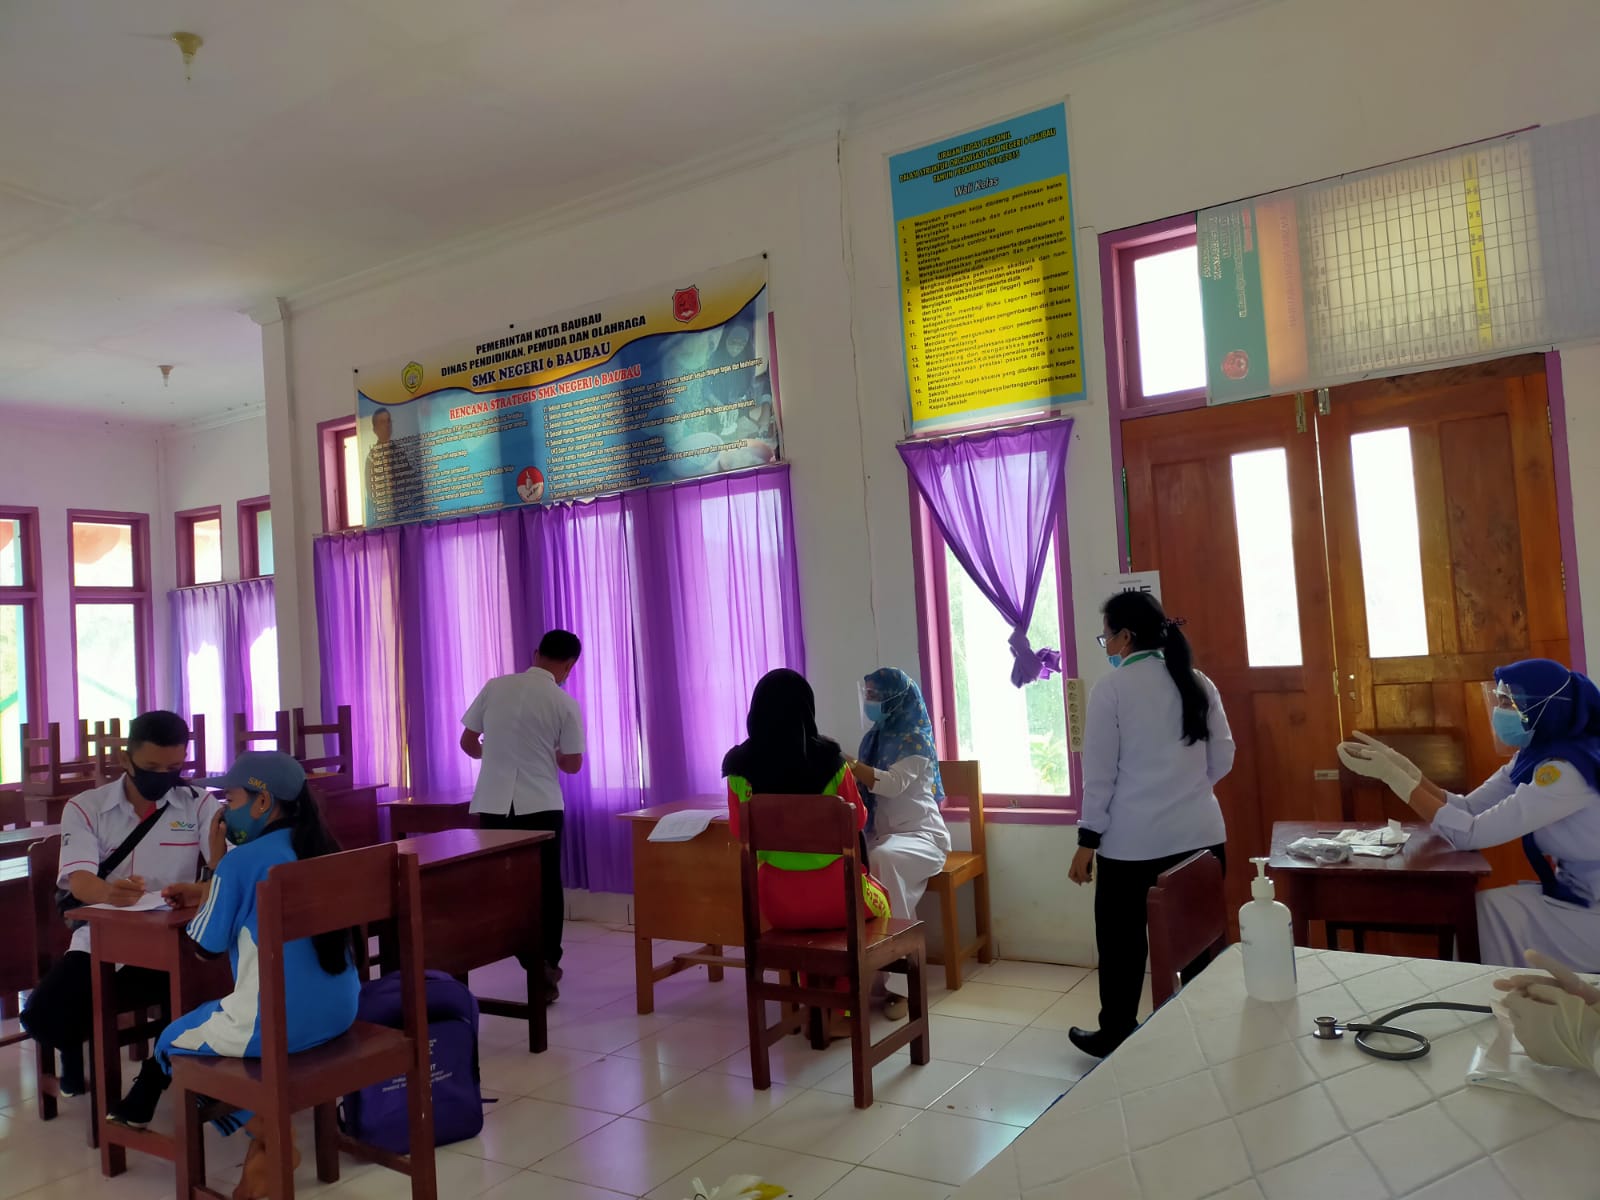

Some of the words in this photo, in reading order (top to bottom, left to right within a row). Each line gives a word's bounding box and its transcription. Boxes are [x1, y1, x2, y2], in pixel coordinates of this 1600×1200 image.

[950, 150, 985, 167] ORGANISASI
[1002, 138, 1022, 151] NEGERI
[982, 131, 1011, 146] PERSONIL
[954, 160, 986, 176] PELAJARAN
[955, 182, 973, 197] Wali
[974, 175, 999, 191] Kelas
[441, 362, 467, 378] DINAS
[469, 346, 526, 371] PENDIDIKAN,
[527, 335, 567, 356] PEMUDA
[569, 329, 590, 345] DAN
[592, 314, 647, 339] OLAHRAGA
[476, 331, 533, 355] PEMERINTAH
[534, 323, 559, 340] KOTA
[561, 312, 602, 333] BAUBAU
[472, 370, 496, 388] SMK
[499, 358, 544, 381] NEGERI
[546, 355, 554, 370] 6
[556, 341, 611, 367] BAUBAU
[449, 399, 489, 421] RENCANA
[490, 388, 537, 412] STRATEGIS
[538, 383, 556, 401] SMK
[558, 375, 593, 396] NEGERI
[594, 373, 600, 388] 6
[601, 364, 642, 387] BAUBAU
